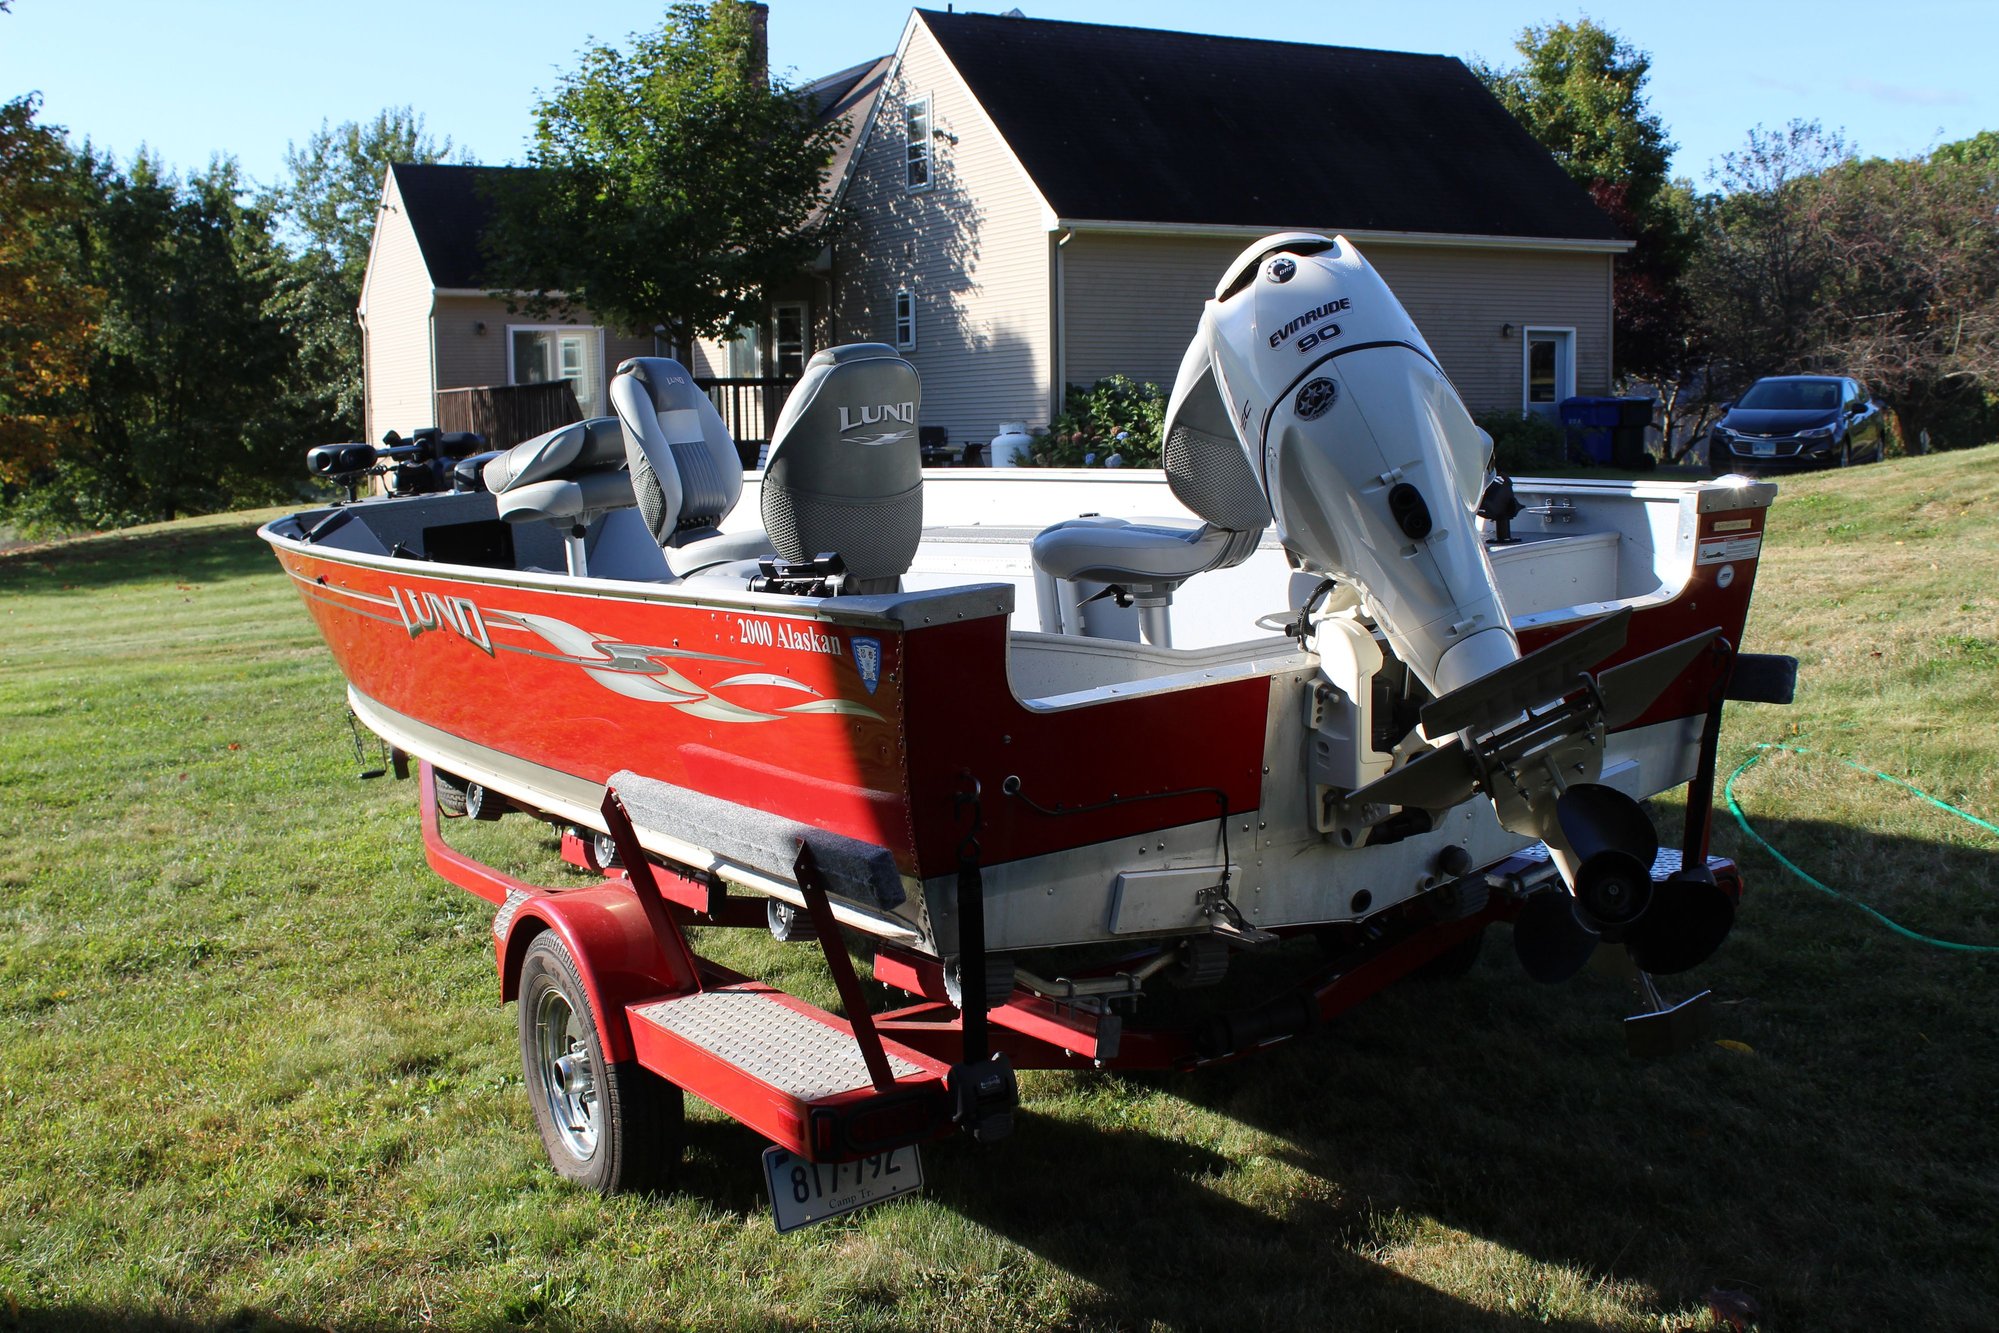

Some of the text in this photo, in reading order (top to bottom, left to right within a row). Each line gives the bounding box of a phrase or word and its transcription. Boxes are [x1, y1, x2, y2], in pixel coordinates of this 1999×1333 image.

[1268, 297, 1351, 348] EVINRUDE
[1297, 323, 1341, 353] 90
[665, 376, 685, 385] LUND
[838, 401, 914, 432] LUND
[388, 585, 496, 660] LUND
[737, 618, 842, 656] 2000 Alaskan
[828, 1195, 857, 1210] Camp
